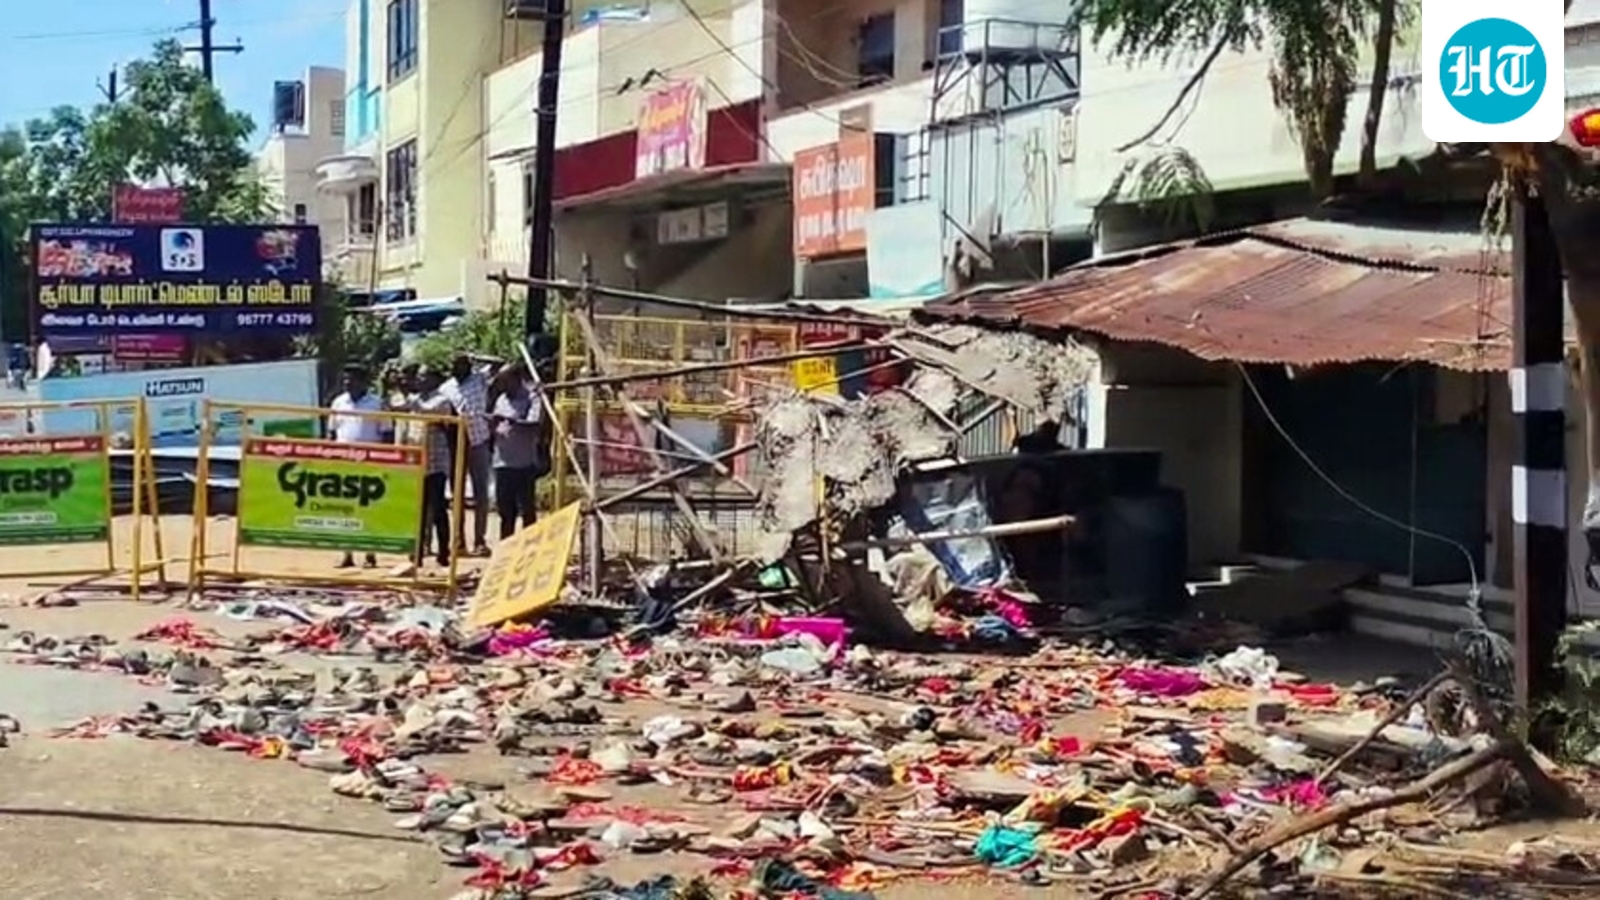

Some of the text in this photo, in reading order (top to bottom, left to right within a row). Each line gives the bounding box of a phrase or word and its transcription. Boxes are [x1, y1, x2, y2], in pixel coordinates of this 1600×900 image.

[40, 279, 94, 309] சூர்யா
[247, 278, 312, 305] ஸ்டோர்
[147, 378, 203, 397] HATSUN
[0, 467, 75, 500] rasp
[277, 461, 386, 509] Grasp
